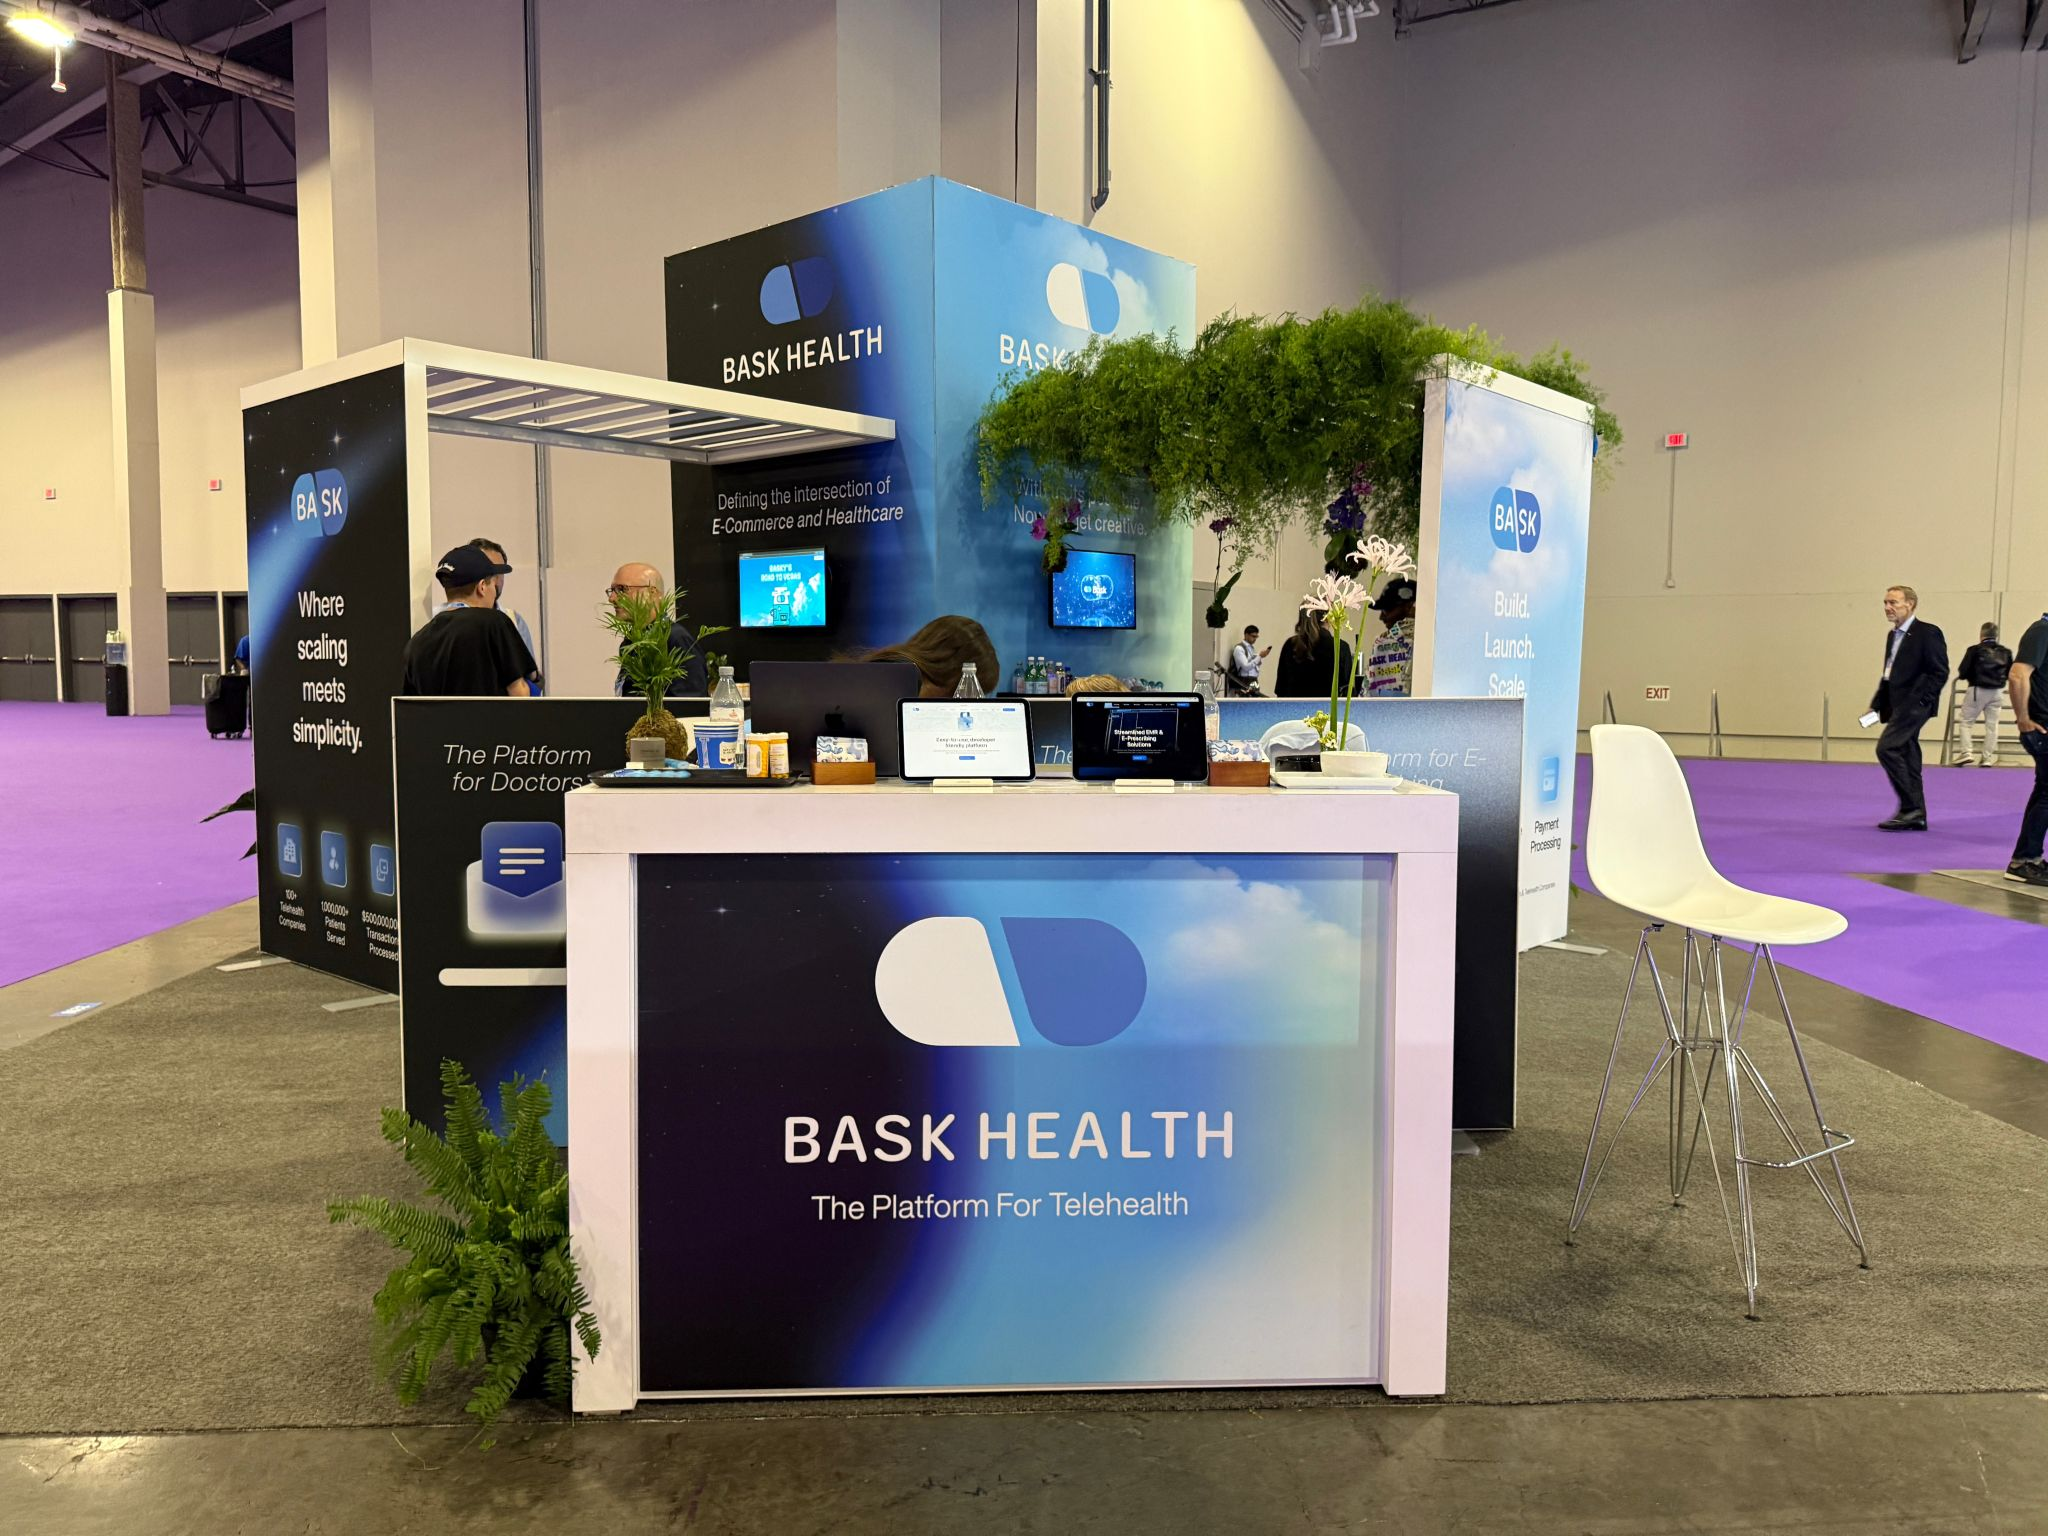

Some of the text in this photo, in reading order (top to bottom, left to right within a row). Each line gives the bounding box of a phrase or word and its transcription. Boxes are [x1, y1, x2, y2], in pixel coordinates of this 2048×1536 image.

[723, 324, 882, 384] BASK HEALTH
[1000, 333, 1066, 374] BASK
[296, 486, 343, 521] BASK
[718, 475, 892, 511] Defining the intersection of
[712, 505, 904, 535] E-Commerce and Healthcare
[1094, 518, 1148, 537] creative.
[1495, 503, 1537, 537] BASK
[298, 591, 345, 618] Where
[1494, 589, 1530, 619] Build.
[298, 633, 348, 667] scaling
[1484, 632, 1535, 660] Launch.
[303, 677, 346, 703] meets
[1646, 687, 1670, 700] EXIT
[293, 717, 362, 754] simplicity.
[444, 744, 592, 766] The Platform
[1428, 748, 1459, 767] for
[1464, 748, 1487, 767] E-
[452, 771, 584, 792] for Doctors
[1534, 818, 1560, 835] Payment
[1530, 836, 1562, 854] Processing
[285, 889, 298, 901] 100+
[280, 901, 305, 917] Telehealth
[321, 901, 349, 917] 1,000,000+
[278, 914, 307, 932] Companies
[325, 916, 346, 932] Patients
[326, 930, 346, 946] Served
[369, 942, 399, 961] Processed
[784, 1111, 1233, 1164] BASK HEALTH
[811, 1190, 1189, 1221] The Platform For Telehealth
